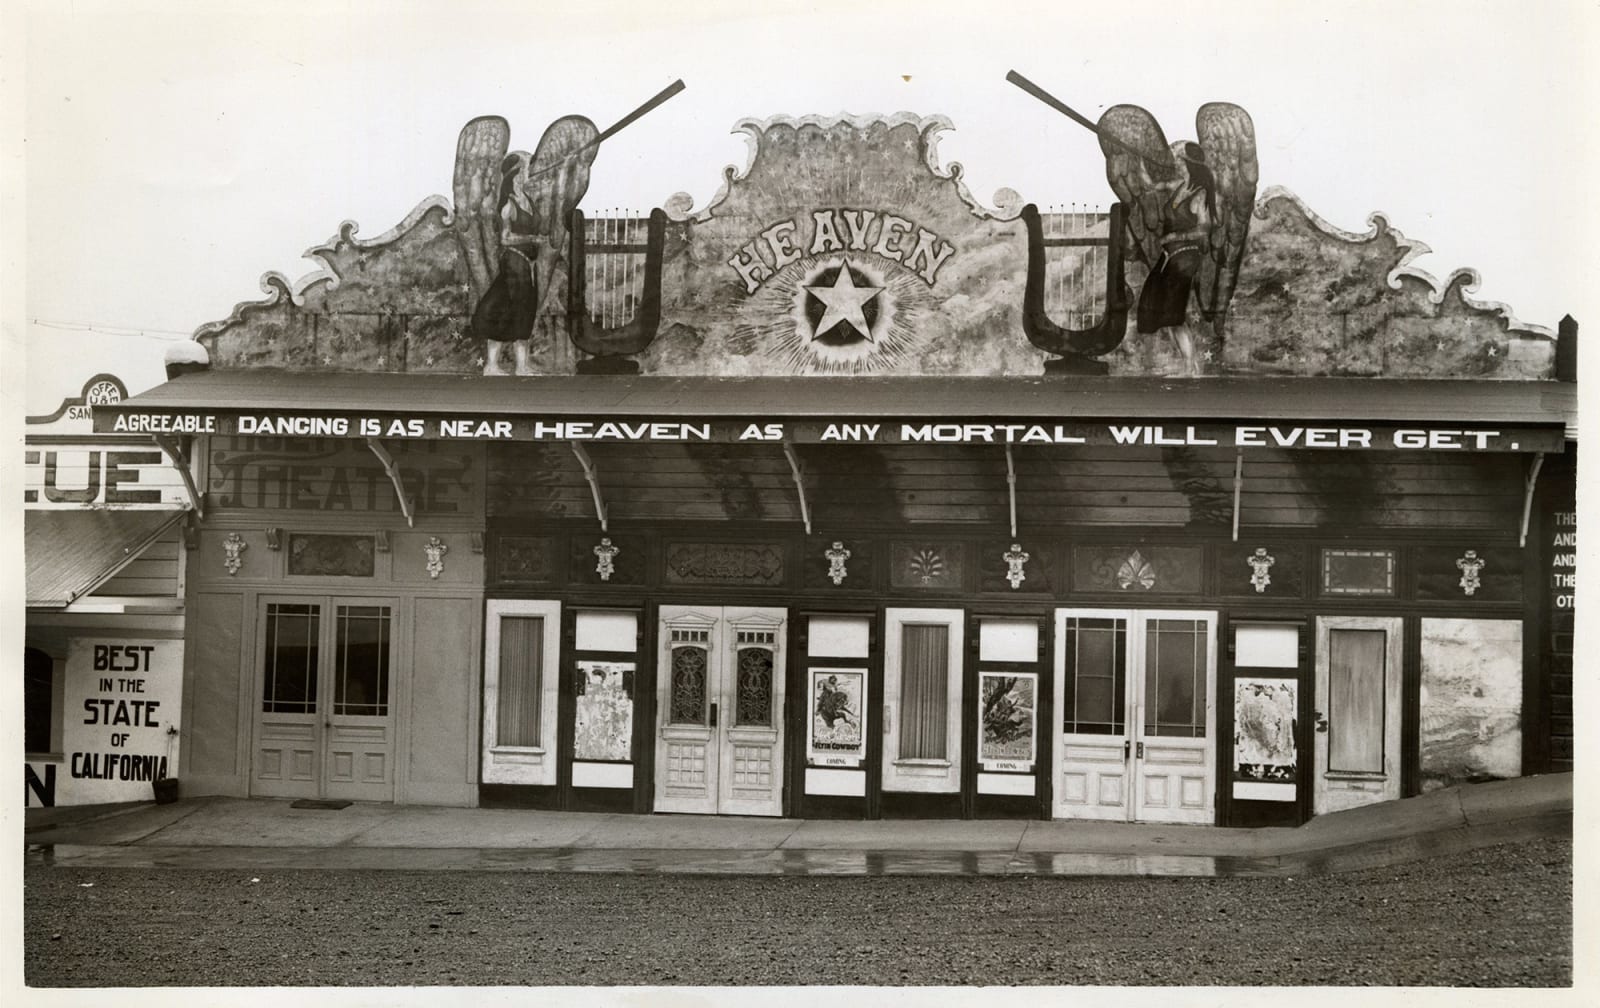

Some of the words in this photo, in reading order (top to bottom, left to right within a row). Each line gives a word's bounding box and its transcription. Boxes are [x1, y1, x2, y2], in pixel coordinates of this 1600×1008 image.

[727, 208, 956, 295] HEAVEN
[113, 414, 216, 433] AGREEABLE
[238, 416, 350, 436] DANCING
[360, 418, 381, 436] IS
[386, 419, 425, 437] AS
[440, 420, 513, 438] NEAR
[534, 422, 710, 440] HEAVEN
[740, 423, 784, 440] AS
[820, 424, 880, 441] ANY
[901, 424, 1086, 443] MORTAL
[1108, 425, 1218, 446] WILL
[1235, 427, 1372, 447] EVER
[25, 451, 162, 503] UE
[212, 452, 470, 512] THEATRE
[93, 645, 155, 672] BEST
[99, 678, 113, 692] IN
[118, 679, 145, 693] THE
[83, 698, 160, 728] STATE
[111, 733, 130, 748] OF
[71, 752, 168, 782] CALIFORNIA
